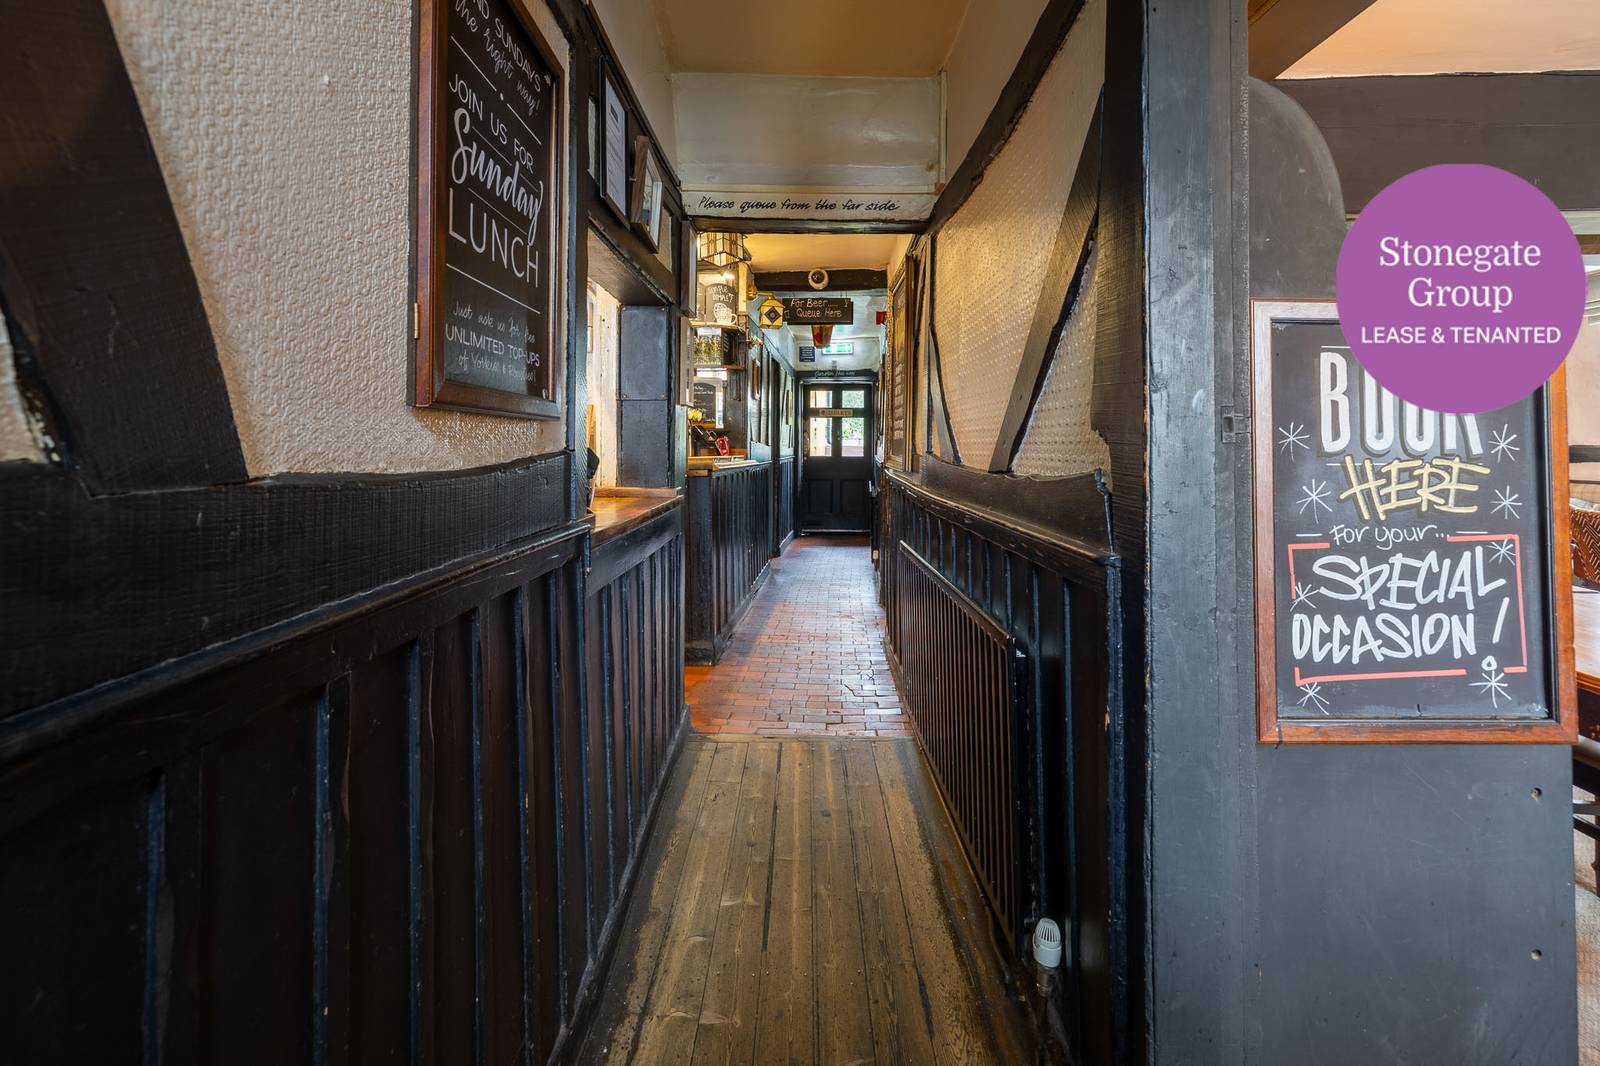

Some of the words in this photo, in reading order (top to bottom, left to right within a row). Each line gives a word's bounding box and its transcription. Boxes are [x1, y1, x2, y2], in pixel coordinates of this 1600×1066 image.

[483, 28, 514, 79] right
[495, 18, 541, 92] SUNDAYS
[449, 74, 483, 121] JOIN
[490, 112, 508, 144] US
[514, 138, 534, 174] FOR
[451, 108, 544, 247] Sunday
[698, 196, 735, 209] Please
[740, 199, 777, 213] queue
[780, 199, 810, 210] from
[815, 199, 836, 210] the
[842, 199, 862, 210] far
[865, 199, 900, 211] side
[448, 187, 539, 288] LUNCH
[453, 300, 473, 320] Just
[791, 298, 805, 308] For
[796, 308, 821, 318] Queue
[445, 323, 505, 355] UNLIMITED
[507, 344, 540, 367] TOP-UPS
[1339, 455, 1491, 521] HERE
[1329, 523, 1370, 545] For
[1312, 546, 1507, 610] SPECIAL
